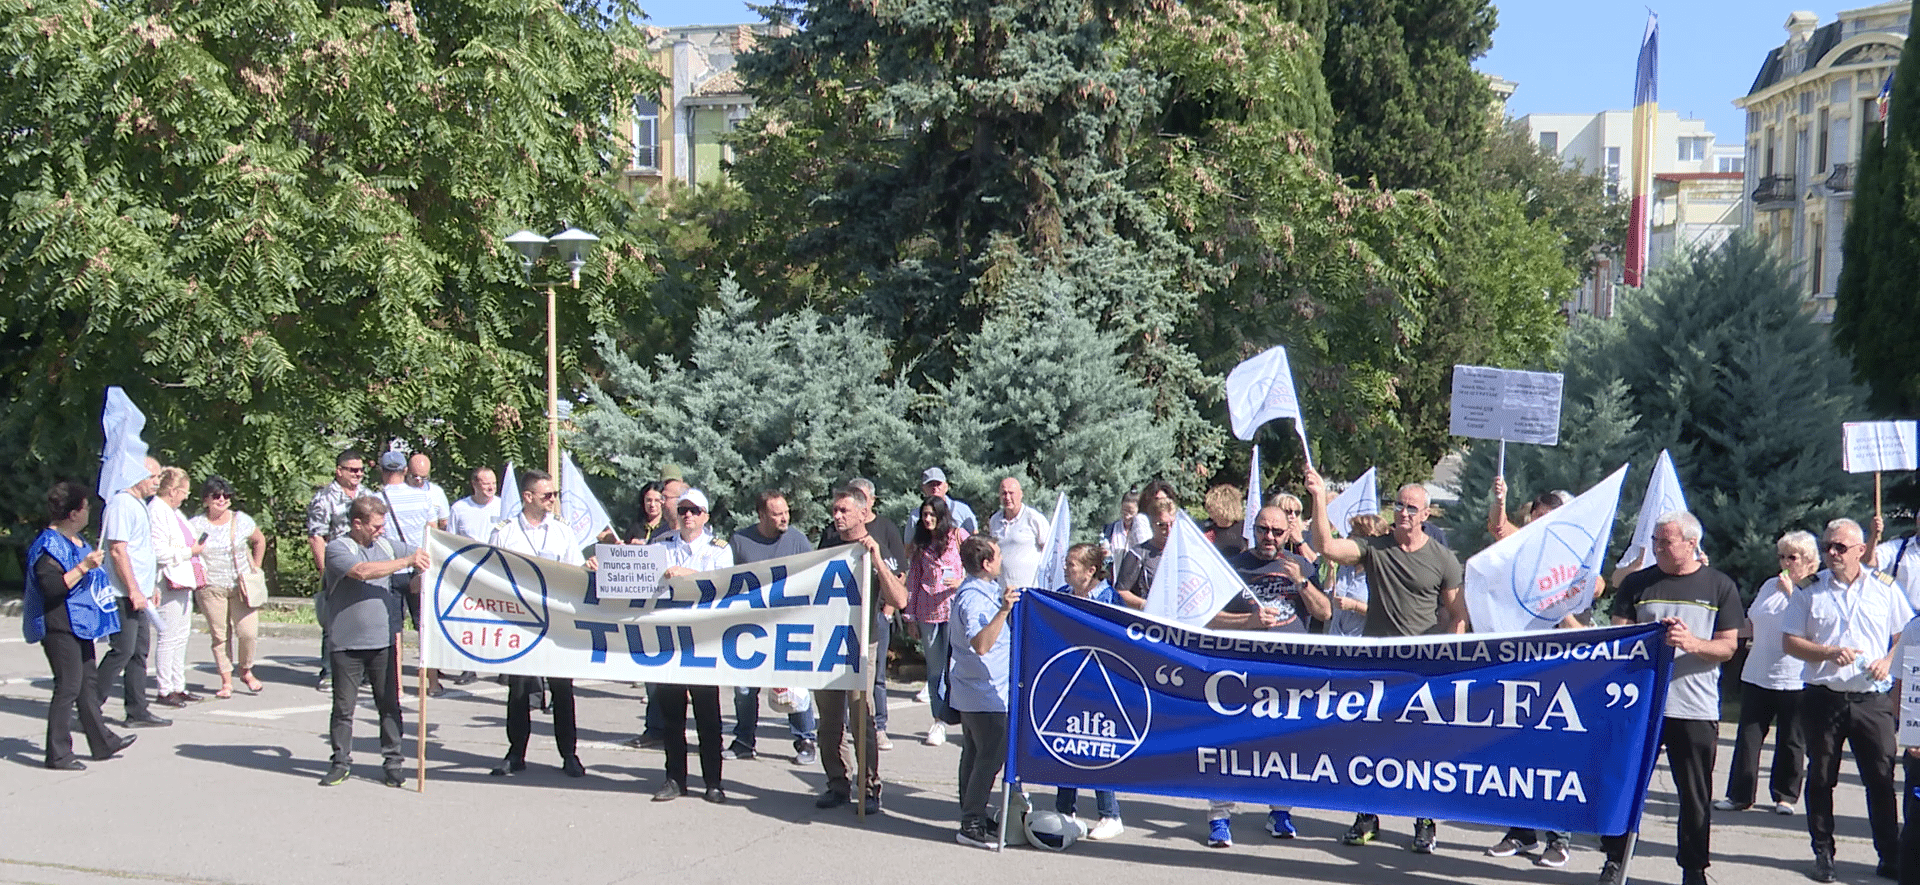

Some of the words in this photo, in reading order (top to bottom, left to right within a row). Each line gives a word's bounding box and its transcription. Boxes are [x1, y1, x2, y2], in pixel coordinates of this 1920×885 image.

[610, 548, 635, 557] Volum
[638, 548, 648, 557] de
[608, 573, 634, 582] Salarii
[637, 573, 654, 582] Mici
[463, 596, 525, 615] CARTEL
[461, 627, 521, 649] alfa
[574, 620, 860, 673] TULCEA
[1498, 640, 1650, 662] SINDICALA
[1204, 670, 1385, 722] Cartel
[1395, 679, 1588, 732] ALFA
[1066, 710, 1117, 738] alfa
[1053, 737, 1120, 759] CARTEL
[1198, 747, 1339, 784] FILIALA
[1348, 755, 1587, 803] CONSTANTA
